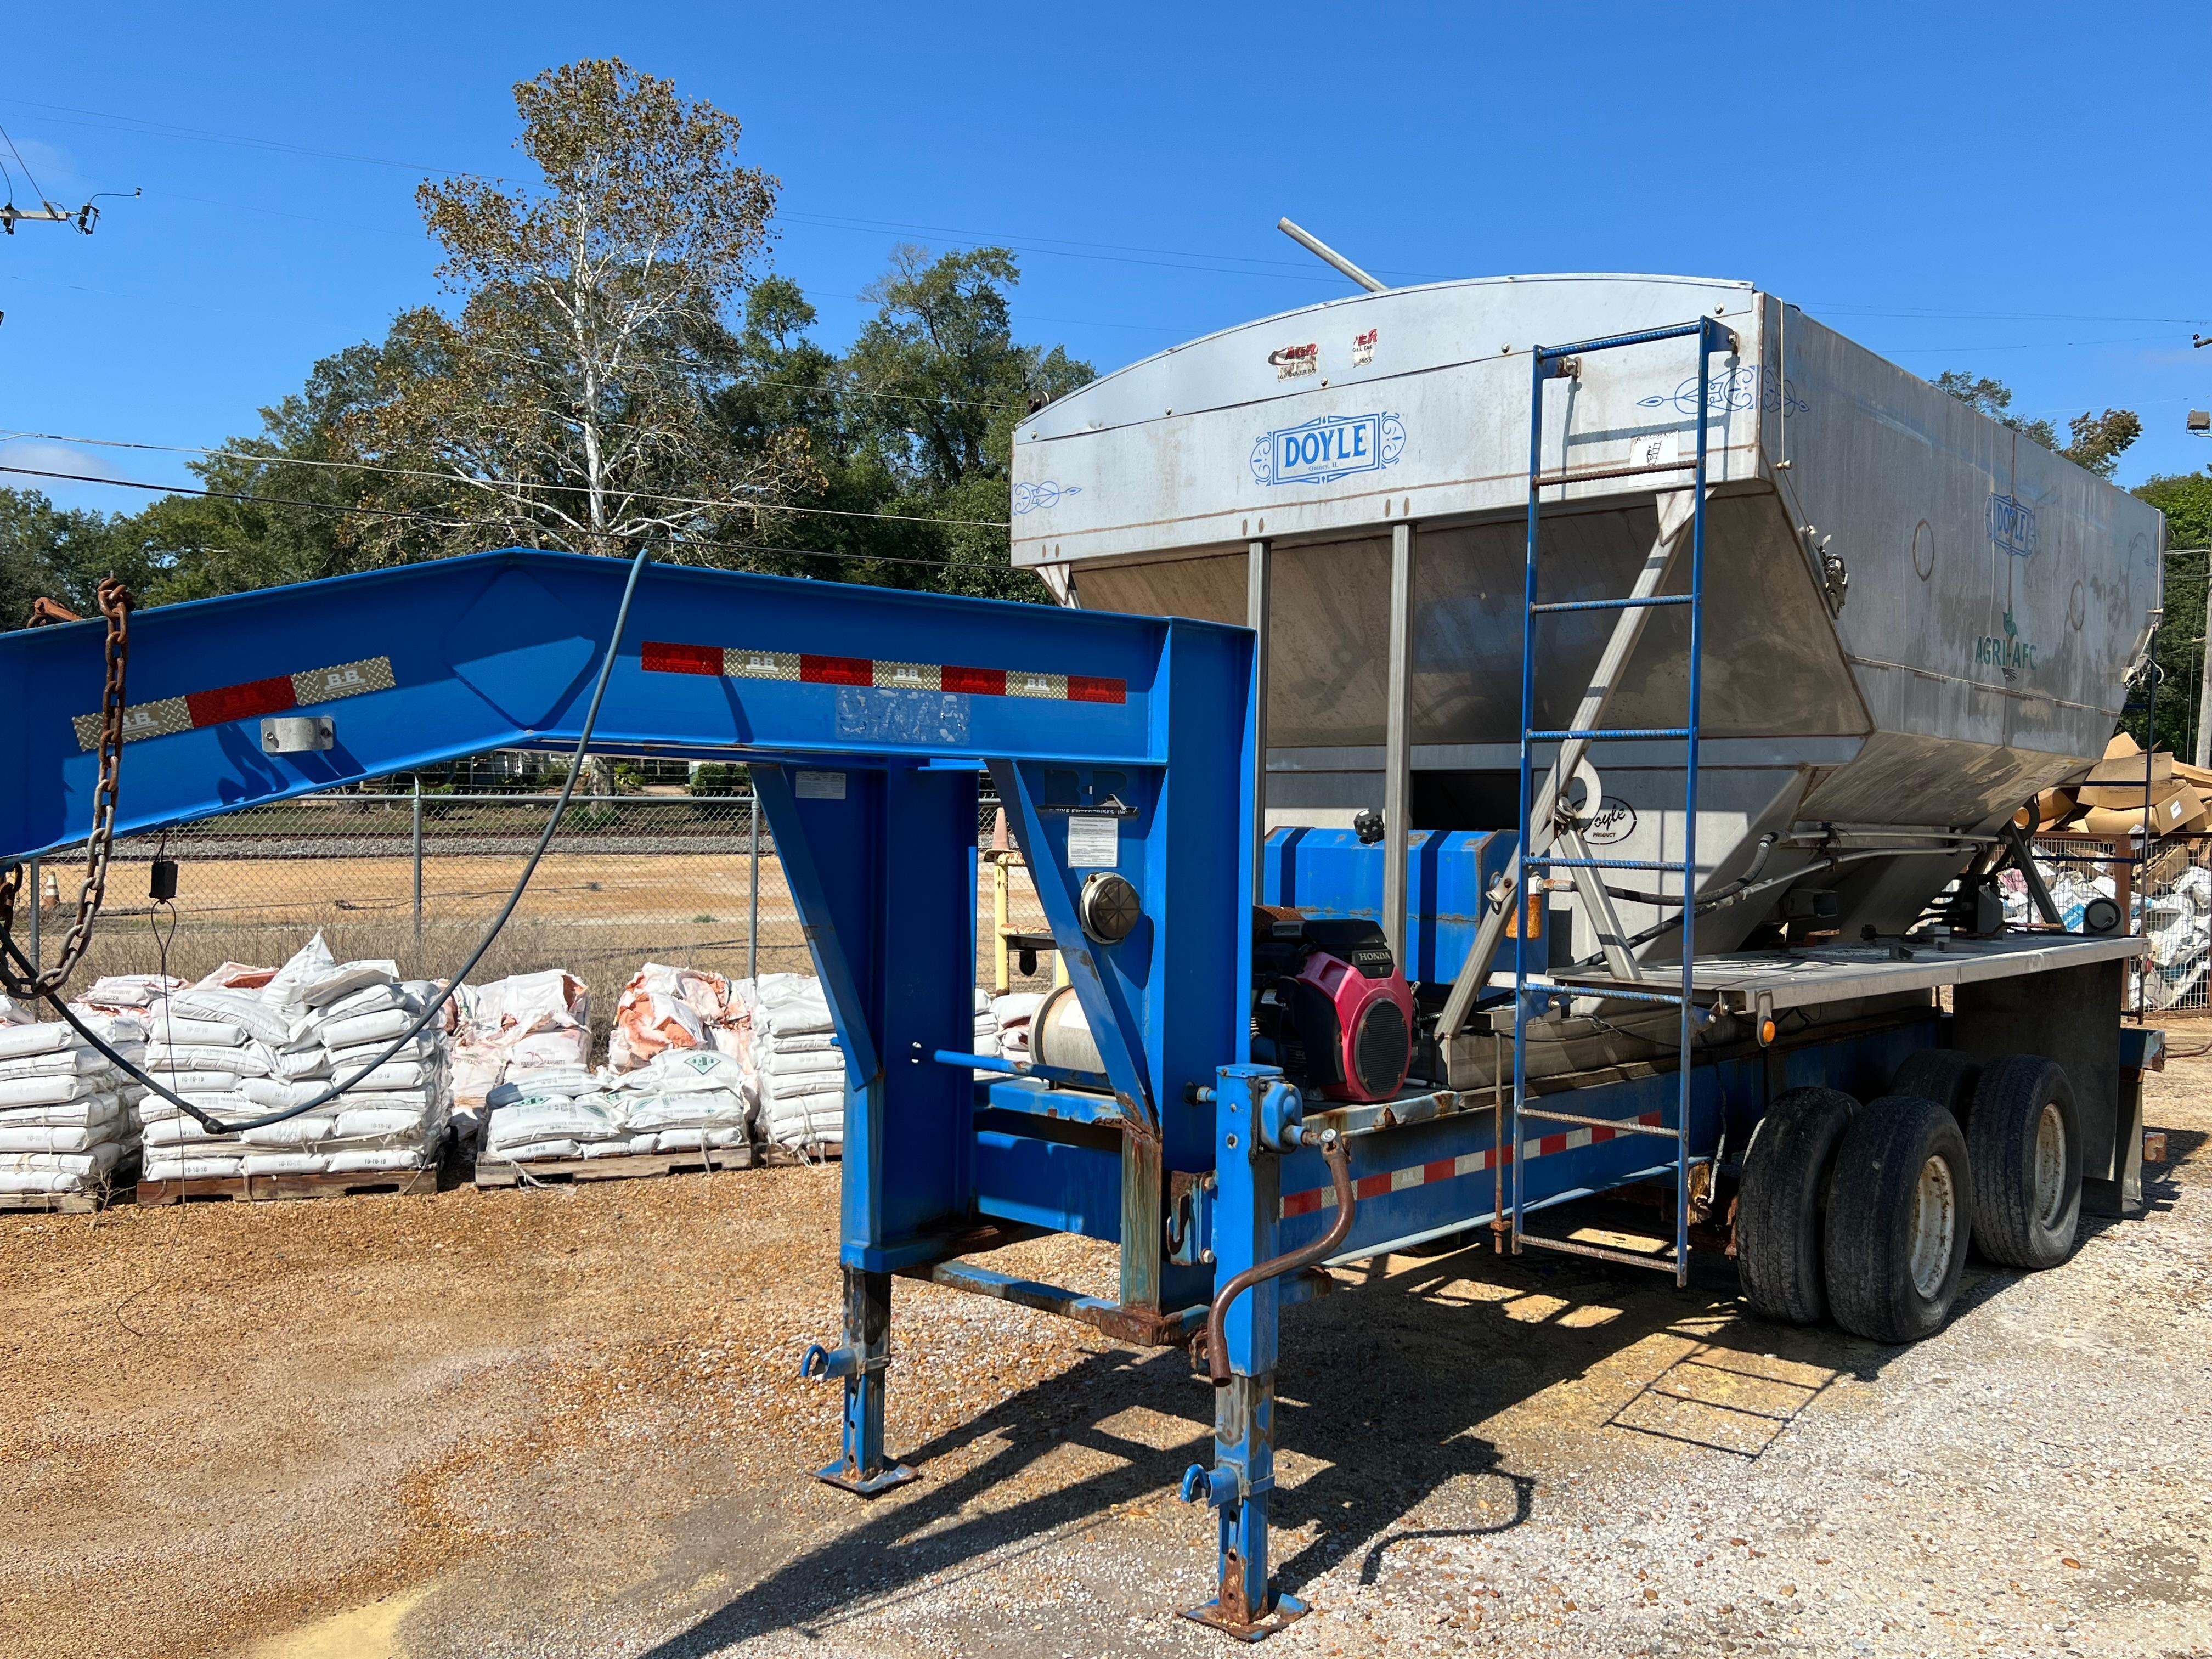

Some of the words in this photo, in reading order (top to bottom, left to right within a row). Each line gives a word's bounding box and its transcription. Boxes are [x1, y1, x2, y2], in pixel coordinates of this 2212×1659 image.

[1284, 424, 1367, 468] DOYLE
[1594, 804, 1626, 831] oyle
[1358, 951, 1391, 961] HONDA
[526, 1144, 546, 1153] 10-10-10
